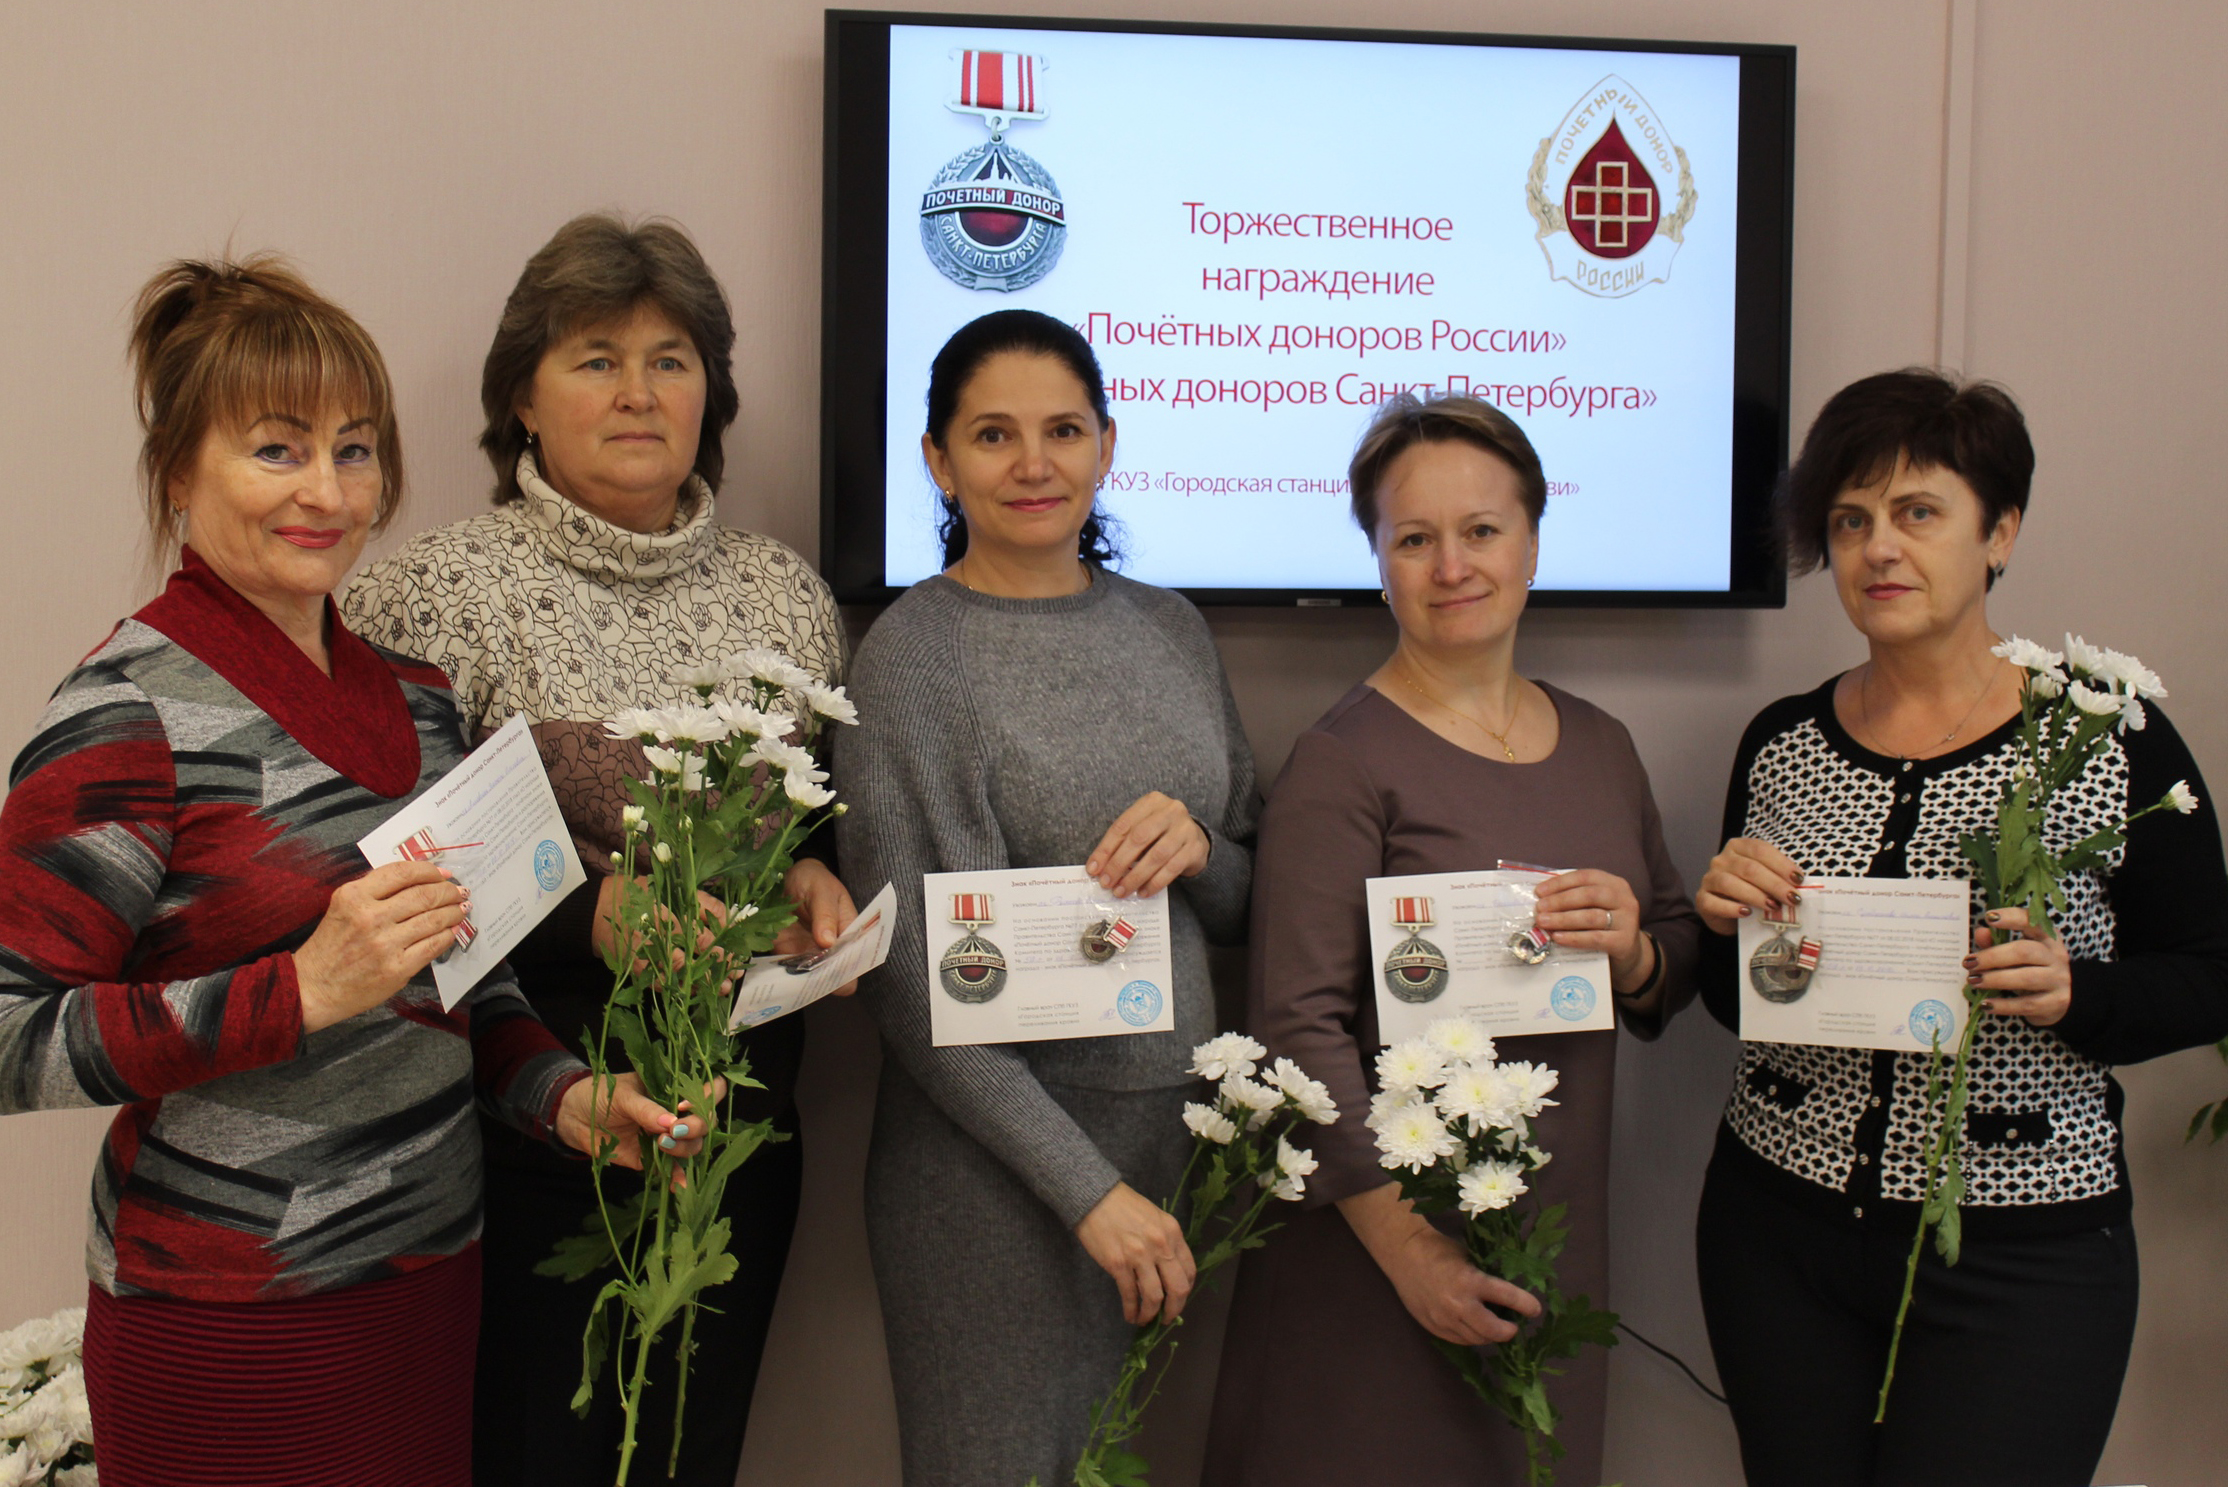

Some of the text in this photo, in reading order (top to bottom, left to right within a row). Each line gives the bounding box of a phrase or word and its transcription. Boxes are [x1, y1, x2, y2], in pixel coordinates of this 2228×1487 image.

[1634, 115, 1673, 173] ДОНОР
[926, 188, 1061, 215] ПОЧЕТНЫЙ ДОНОР
[1182, 202, 1453, 244] Торжественное
[1202, 267, 1435, 301] награждение
[1577, 259, 1644, 292] РОССИИ
[1268, 324, 1422, 358] доноров
[1431, 319, 1567, 353] России»
[1172, 378, 1328, 412] доноров
[1108, 471, 1351, 498] КУЗ «Городская станци
